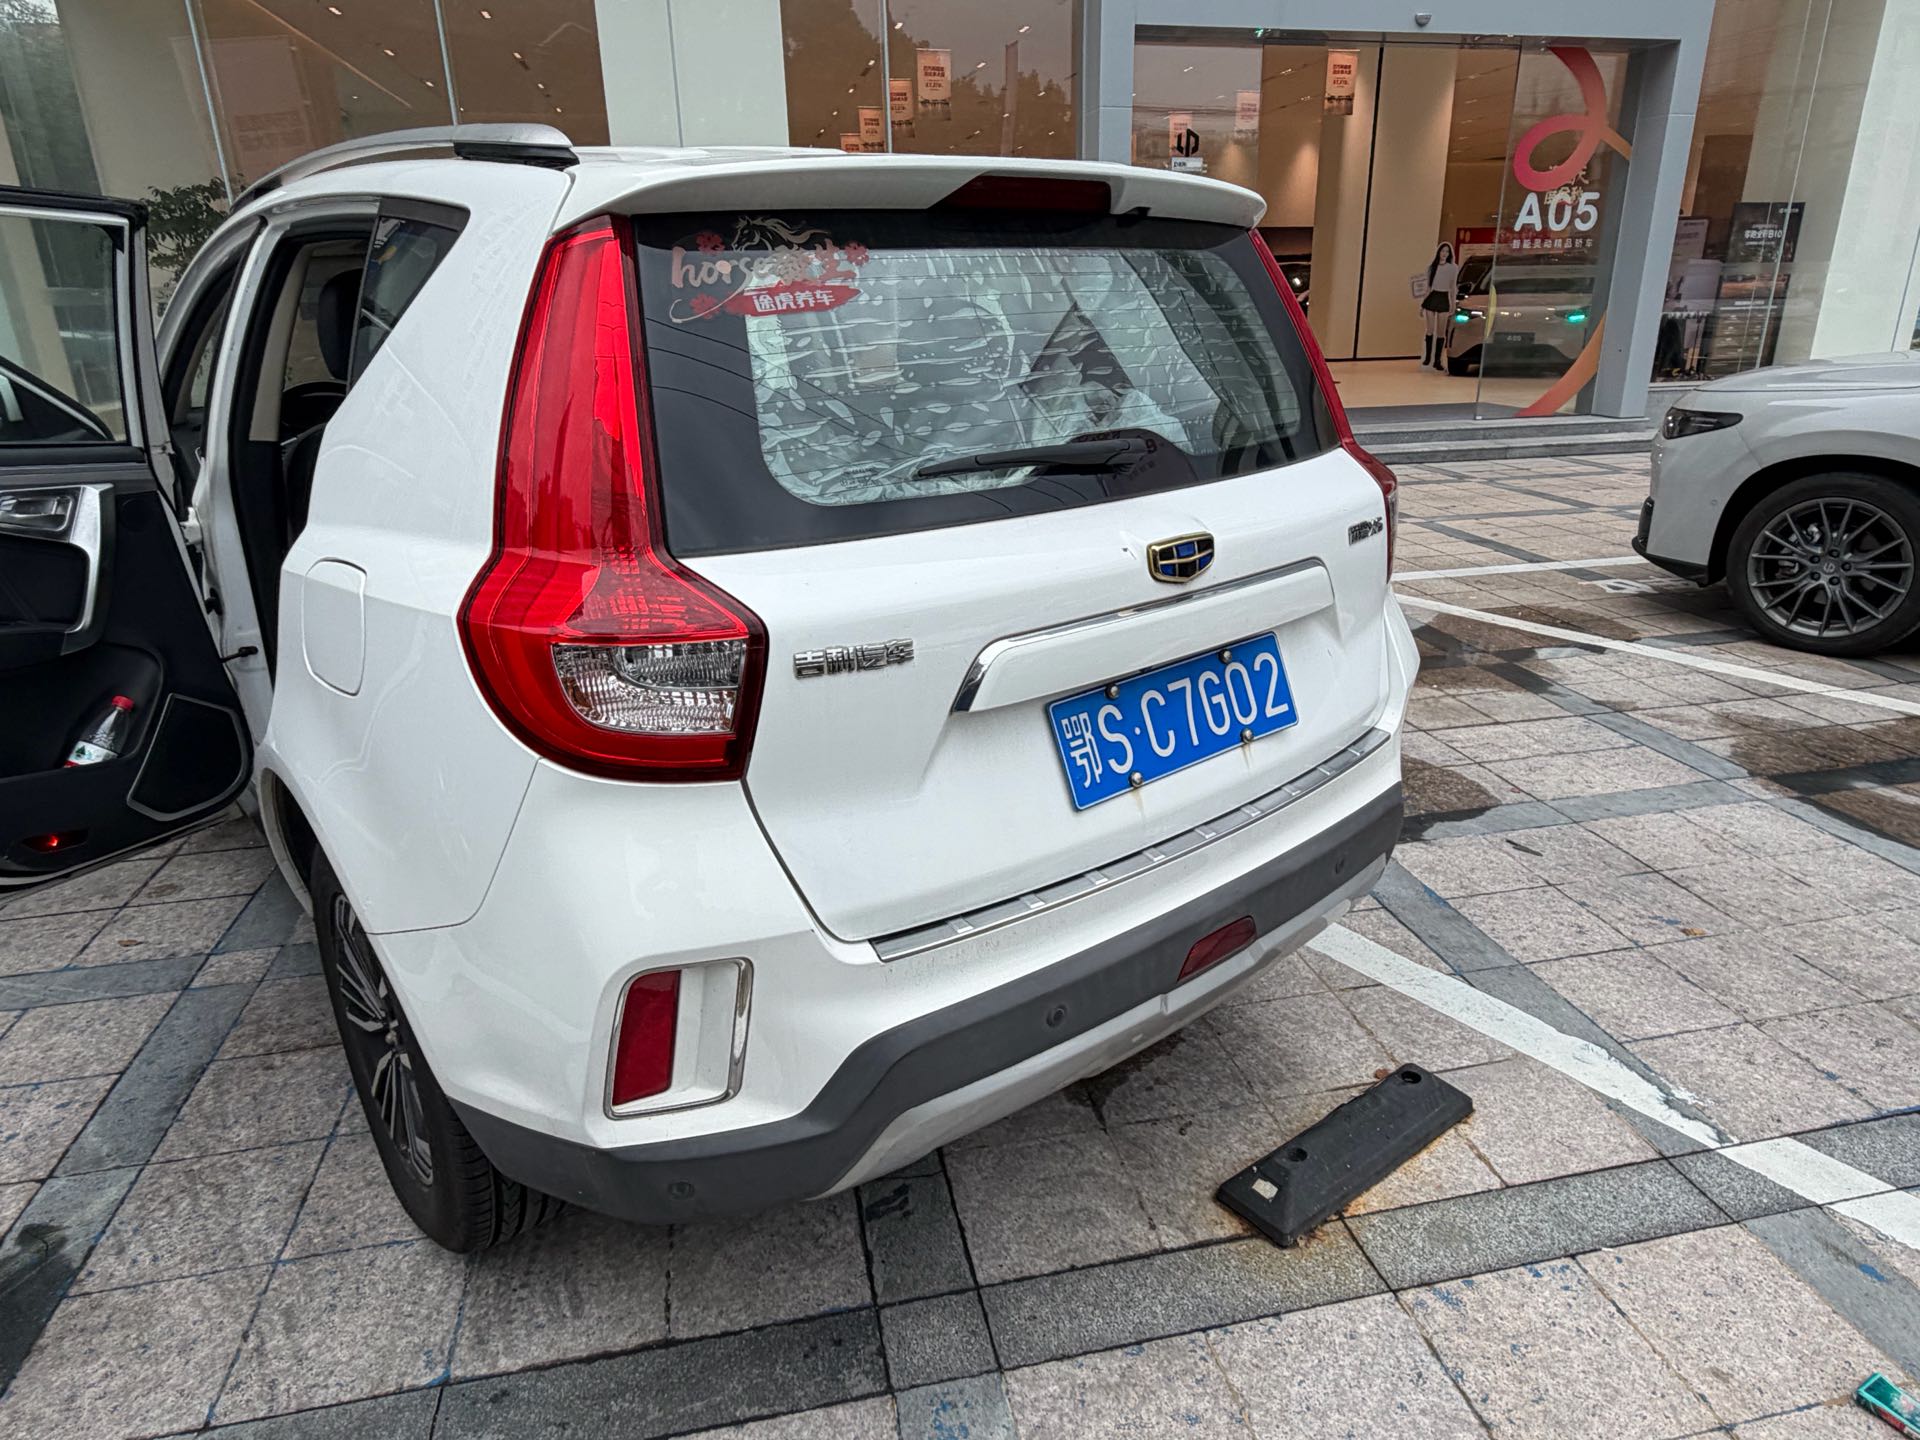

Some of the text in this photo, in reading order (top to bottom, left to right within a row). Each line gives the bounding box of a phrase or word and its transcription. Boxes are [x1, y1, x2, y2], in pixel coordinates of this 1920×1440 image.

[1513, 191, 1601, 232] A05
[1512, 238, 1594, 249] 智能灵动精品轿车
[752, 289, 835, 312] 途虎养车
[793, 638, 914, 680] 吉利汽车
[1061, 652, 1290, 789] 鄂S·C7G02
